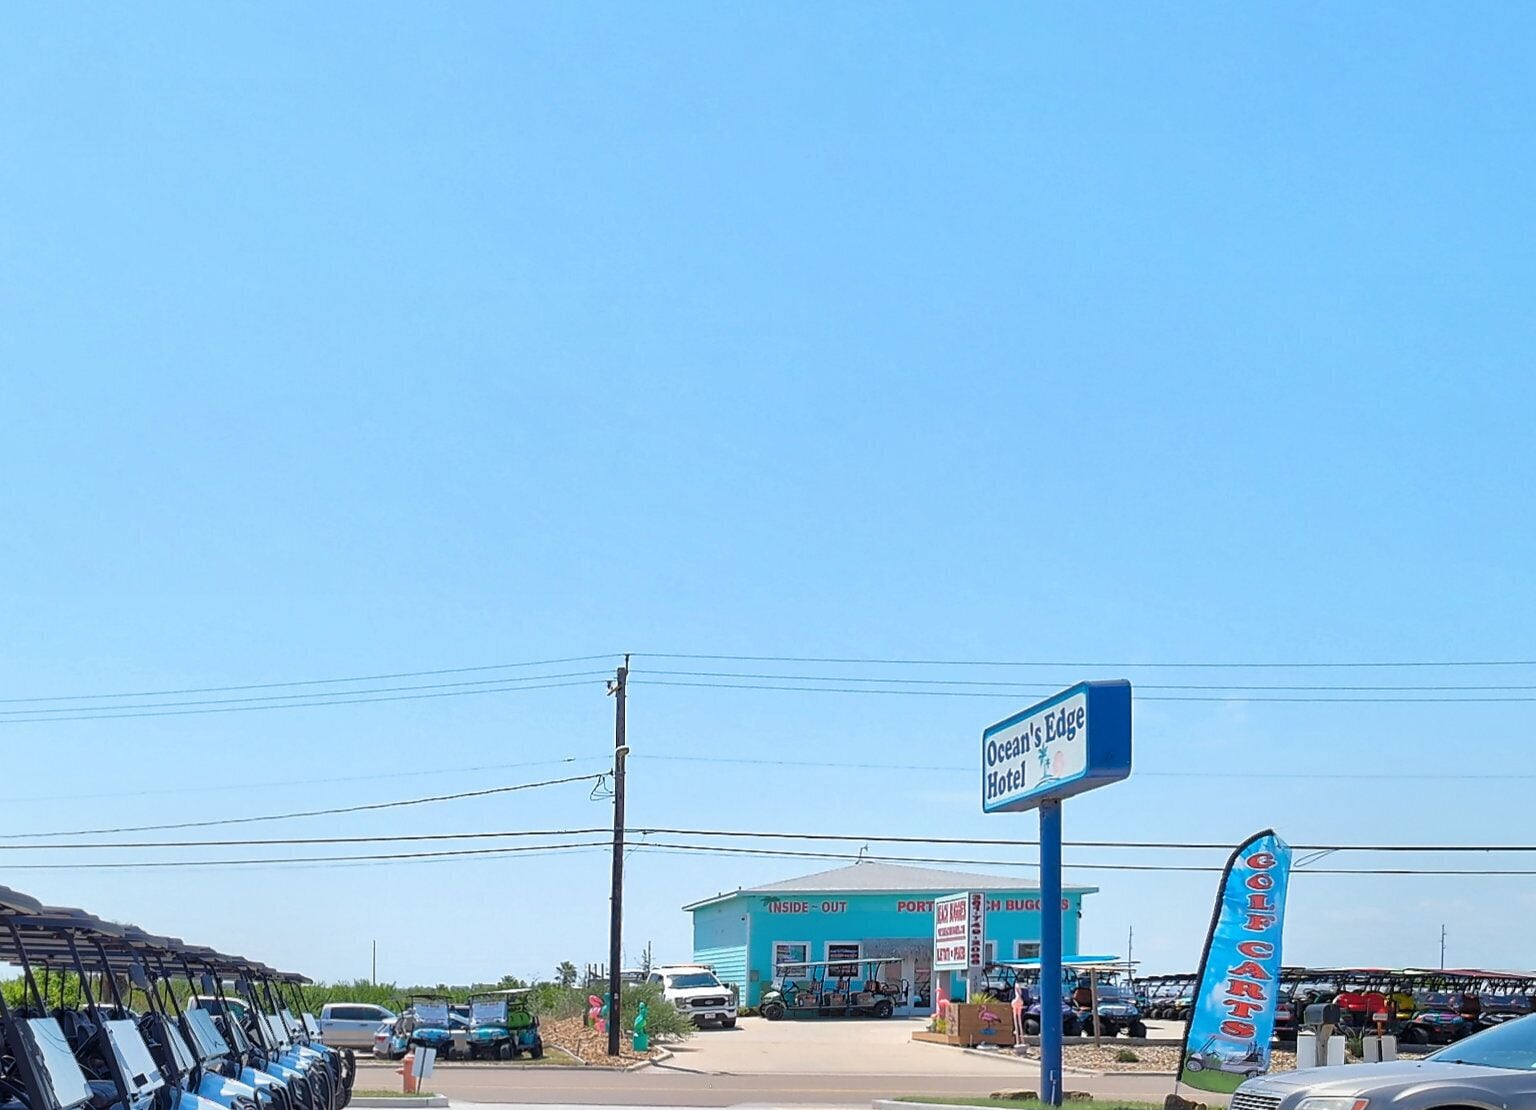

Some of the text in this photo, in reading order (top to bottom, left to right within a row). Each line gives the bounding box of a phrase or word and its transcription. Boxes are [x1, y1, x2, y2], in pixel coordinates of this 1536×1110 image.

[987, 706, 1085, 767] Ocean's Edge
[987, 761, 1026, 799] Hotel
[768, 901, 808, 913] INSIDE
[822, 901, 847, 913] OUT
[897, 901, 934, 912] PORT
[1220, 852, 1278, 1039] GOLF CARTS
